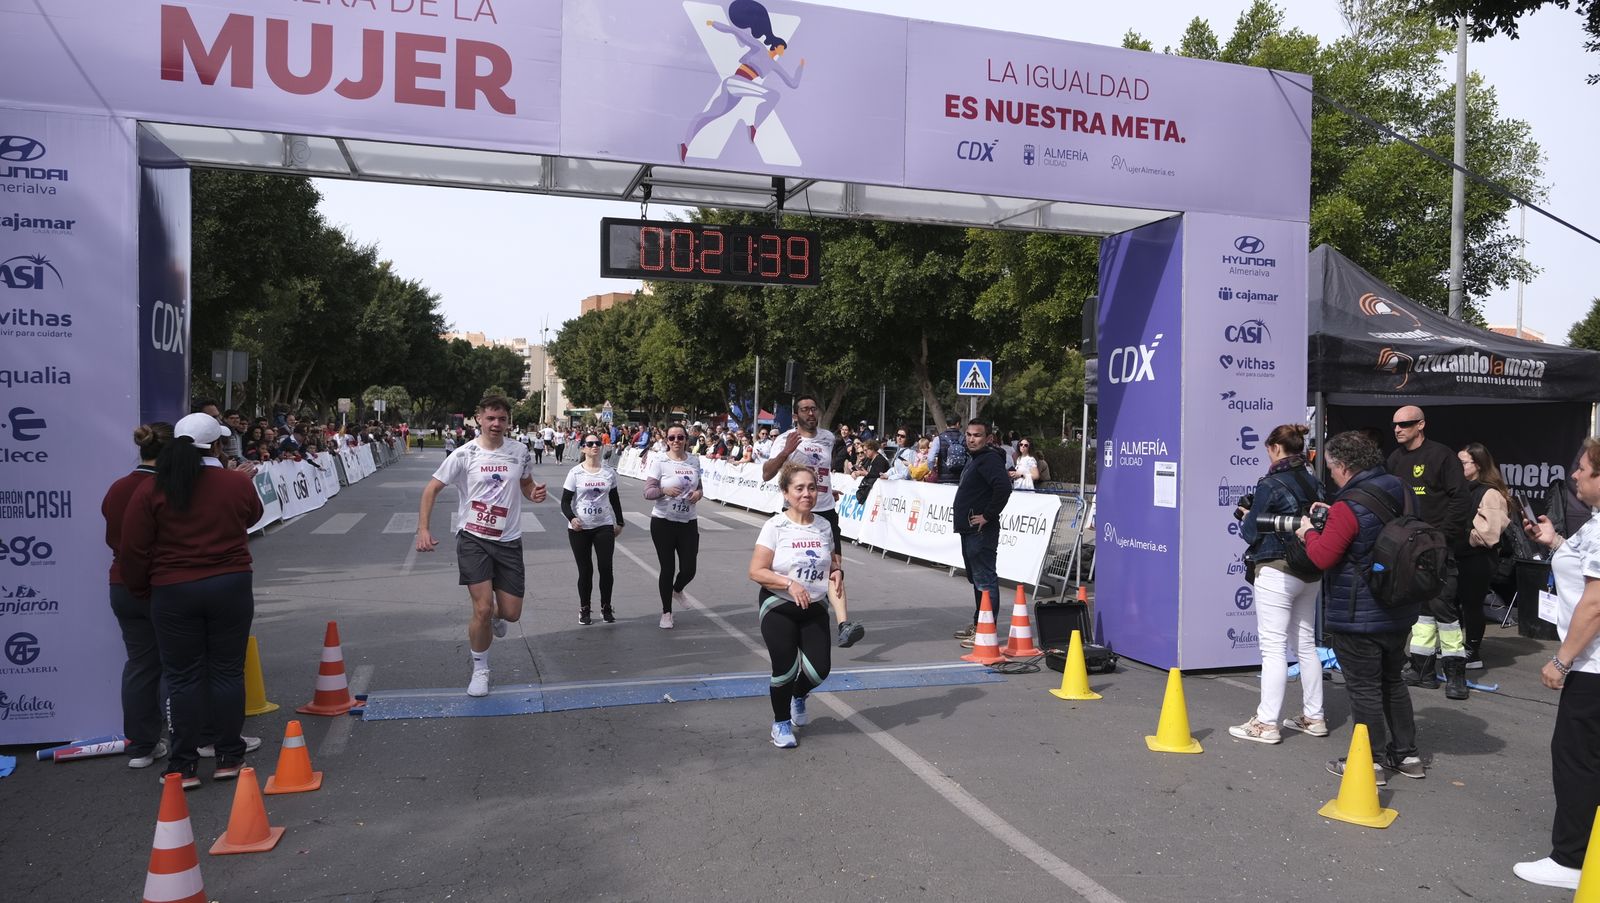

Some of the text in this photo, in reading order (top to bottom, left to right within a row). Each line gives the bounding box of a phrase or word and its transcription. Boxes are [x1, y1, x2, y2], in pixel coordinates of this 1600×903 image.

[161, 5, 516, 115] MUJER
[987, 58, 1150, 102] LA IGUALDAD
[945, 94, 1186, 144] ES NUESTRA META.
[957, 139, 999, 163] CDX
[1044, 145, 1088, 163] ALMERÍA
[640, 227, 809, 279] 00:21:39
[1222, 255, 1276, 267] HYUNDAI
[1229, 267, 1270, 278] Almerialva
[1236, 290, 1278, 303] cajamar
[0, 308, 72, 327] vithas
[37, 330, 72, 338] cuidarte
[1225, 325, 1262, 344] CASI
[1108, 333, 1163, 384] CDX
[1236, 357, 1275, 370] vithas
[1228, 397, 1273, 412] aqualia
[1120, 438, 1168, 456] ALMERÍA
[1120, 457, 1143, 467] CIUDAD
[1230, 454, 1259, 466] Clece
[25, 490, 71, 518] CASH
[927, 503, 954, 522] ALME
[476, 512, 497, 525] 946
[792, 541, 822, 549] MUJER
[796, 567, 824, 581] 1184
